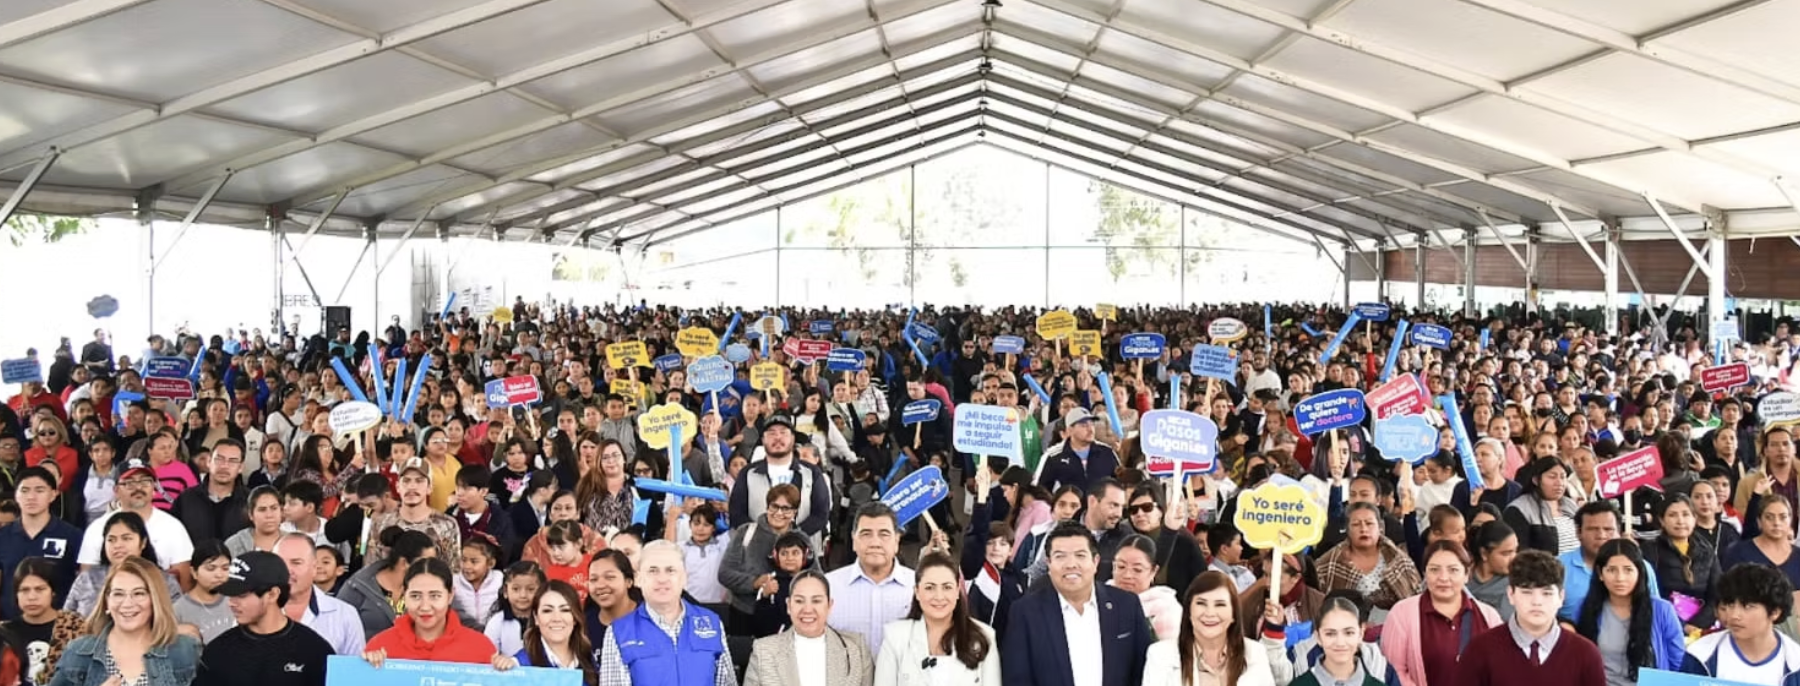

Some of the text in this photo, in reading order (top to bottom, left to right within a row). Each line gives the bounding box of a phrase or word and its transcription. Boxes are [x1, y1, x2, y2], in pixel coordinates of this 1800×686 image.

[1124, 346, 1160, 355] Gigantes
[1300, 397, 1347, 413] De grande
[661, 412, 682, 421] seré
[965, 411, 1005, 421] ¡Mi beca
[1309, 408, 1339, 420] quiero
[974, 420, 1013, 432] impulsa
[1300, 413, 1353, 430] ser doctora
[974, 430, 1003, 440] seguir
[1157, 418, 1201, 441] Pasos
[957, 438, 1013, 450] estudiando!
[1149, 433, 1208, 455] Gigantes
[1252, 497, 1304, 512] Yo seré
[1242, 508, 1312, 525] ingeniero
